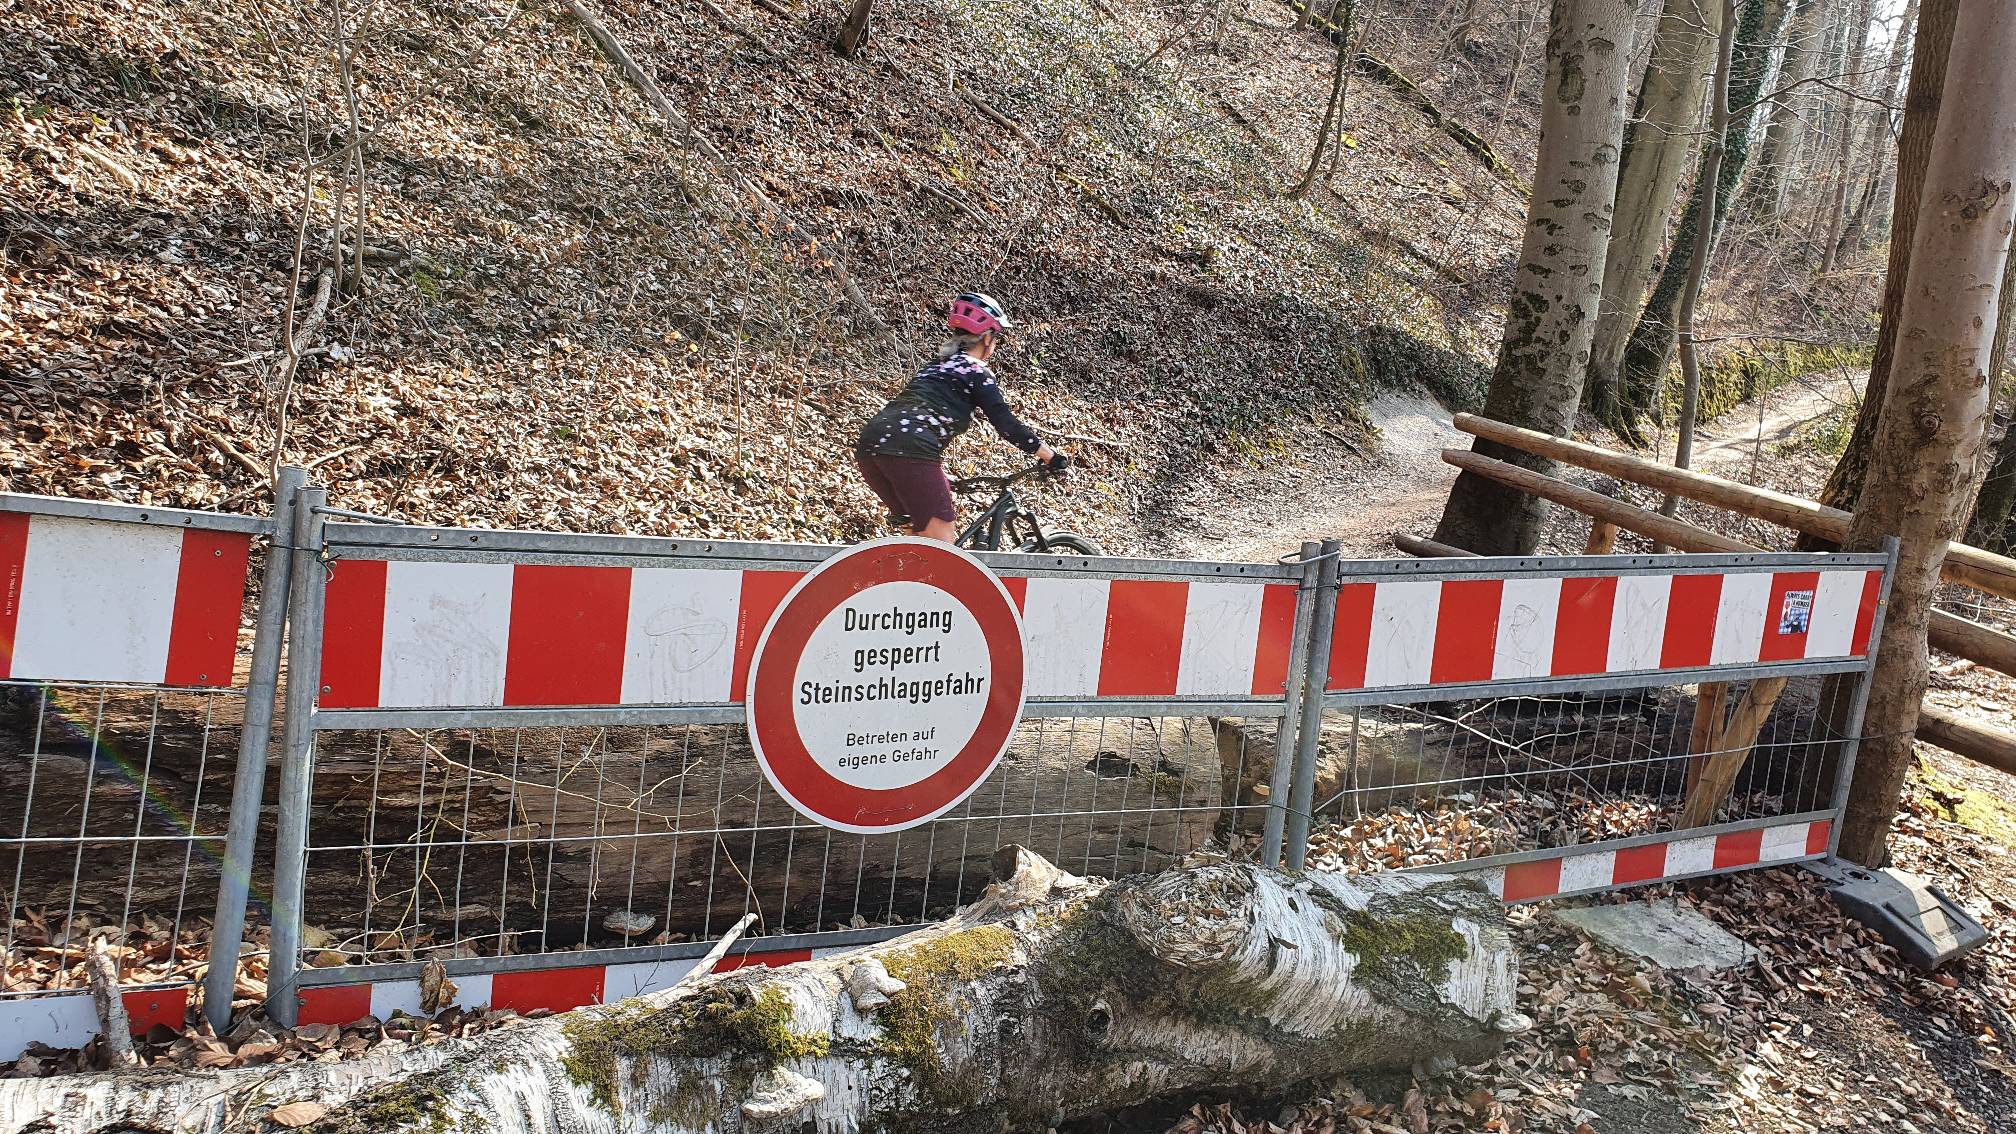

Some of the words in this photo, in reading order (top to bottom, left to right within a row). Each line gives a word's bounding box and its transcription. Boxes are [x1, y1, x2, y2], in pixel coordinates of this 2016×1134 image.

[844, 606, 953, 636] Durchgang
[853, 640, 941, 673] gesperrt
[800, 671, 985, 706] Steinschlaggefahr
[846, 730, 908, 747] Betreten
[912, 726, 936, 741] auf
[838, 753, 887, 770] eigene
[892, 746, 940, 763] Gefahr
